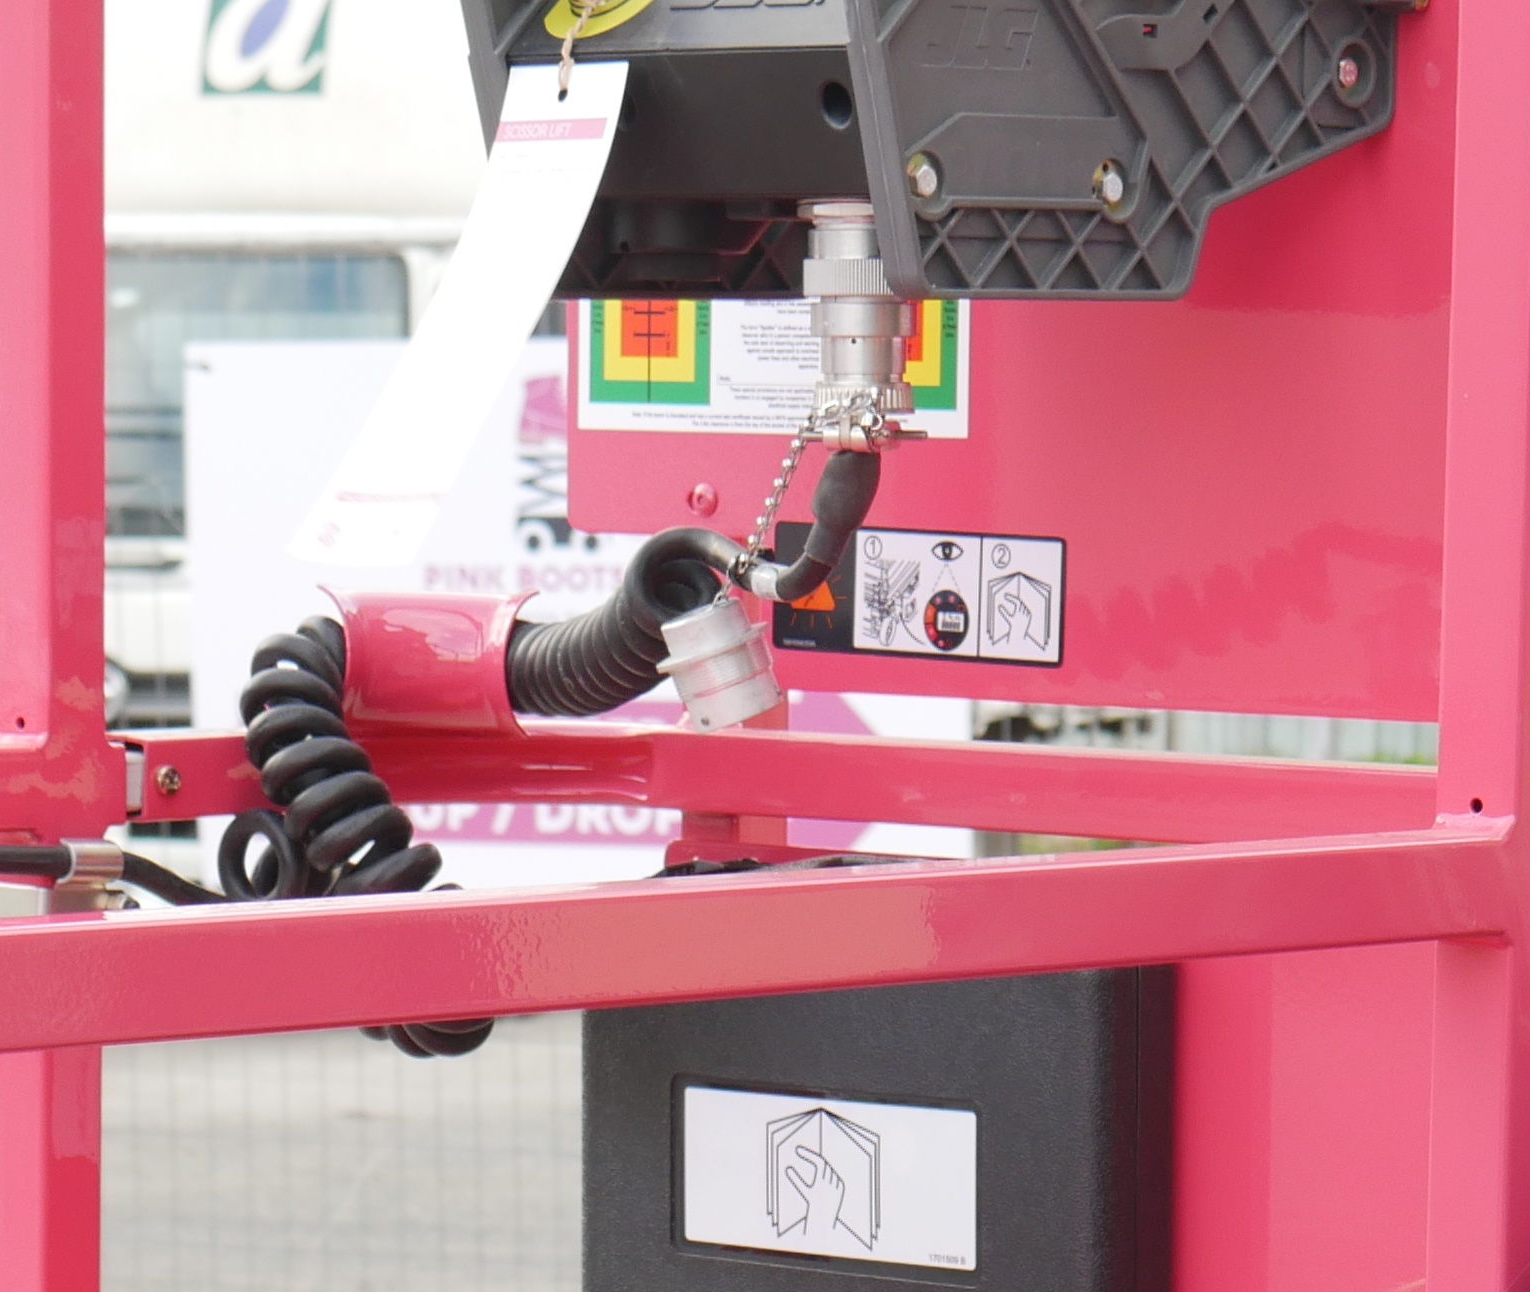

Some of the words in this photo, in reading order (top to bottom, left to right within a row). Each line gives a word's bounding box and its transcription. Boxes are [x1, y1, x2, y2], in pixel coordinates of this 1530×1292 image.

[503, 123, 547, 140] SCISSOR
[549, 122, 573, 138] LIFT
[425, 564, 504, 591] PINK
